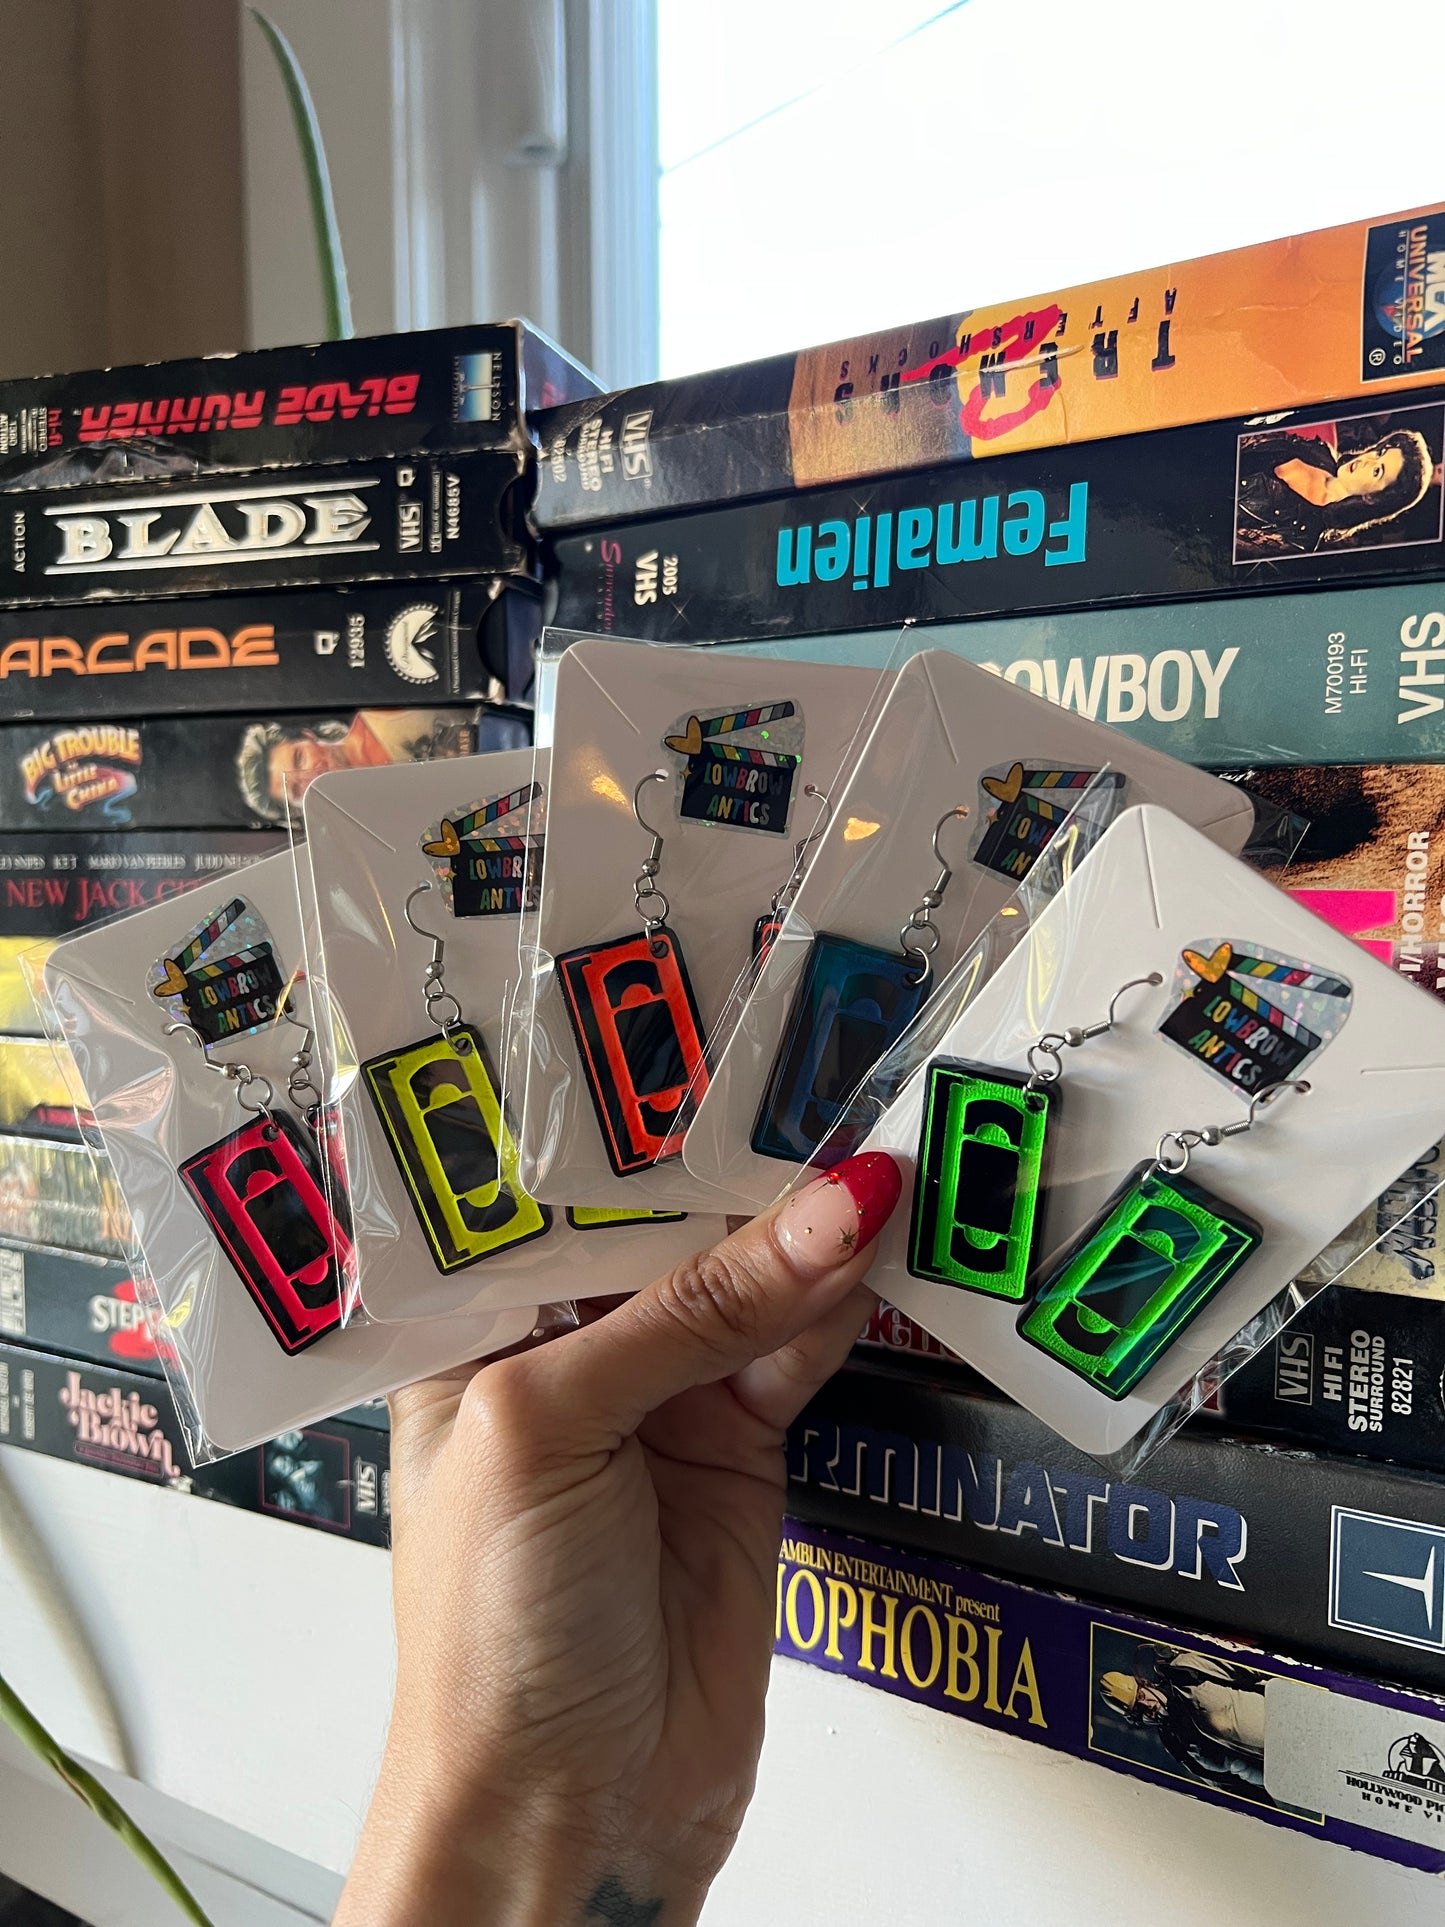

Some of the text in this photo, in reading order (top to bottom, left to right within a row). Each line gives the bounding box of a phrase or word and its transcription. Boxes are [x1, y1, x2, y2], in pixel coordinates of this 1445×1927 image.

[1395, 231, 1407, 282] HOME
[1405, 225, 1427, 363] UNIVERSAL
[839, 288, 1177, 380] AFTERSHOCKS
[275, 374, 421, 425] BLADE
[491, 352, 502, 421] NELSON
[834, 320, 1176, 426] TREMORS
[38, 406, 48, 452] STEREO
[78, 391, 265, 442] RUNNER
[623, 412, 651, 477] VHS
[576, 422, 590, 490] SURROUND
[587, 418, 602, 492] STEREO
[600, 429, 614, 473] HI FI
[14, 511, 26, 573] ACTION
[56, 490, 371, 565] BLADE
[399, 505, 421, 551] VHS
[776, 481, 1089, 591] Femalien
[634, 550, 659, 606] VHS
[663, 555, 679, 596] 2005
[0, 623, 280, 679] ARCADE
[1325, 632, 1346, 714] M700193
[1350, 649, 1369, 694] HI-FI
[1397, 612, 1445, 724] VHS
[978, 647, 1240, 723] OWBOY
[21, 725, 142, 782] BIG TROUBLE
[704, 762, 785, 796] LOWBROW
[706, 794, 771, 825] ANTICS
[469, 855, 523, 881] LOWBR
[1000, 851, 1032, 876] AN
[6, 877, 70, 908] NEW
[74, 876, 150, 921] JACK
[198, 963, 274, 1009] LOWBROW
[217, 995, 276, 1034] ANTICS
[1188, 1029, 1262, 1086] ANTICS
[1203, 995, 1297, 1066] LOWBROW
[1278, 1335, 1310, 1401] VHS
[1322, 1345, 1344, 1402] HI FI
[1348, 1329, 1371, 1433] STEREO
[1369, 1335, 1386, 1433] SURROUND
[1391, 1357, 1414, 1416] 82821
[59, 1371, 158, 1429] Jackie
[69, 1408, 181, 1477] Brown
[357, 1465, 376, 1513] VHS
[785, 1425, 1246, 1590] RMINATOR
[779, 1538, 1000, 1622] AMBLIN ENTERTAINMENT present
[1345, 1775, 1423, 1806] HOLLYWOOD
[1362, 1791, 1413, 1813] HOME
